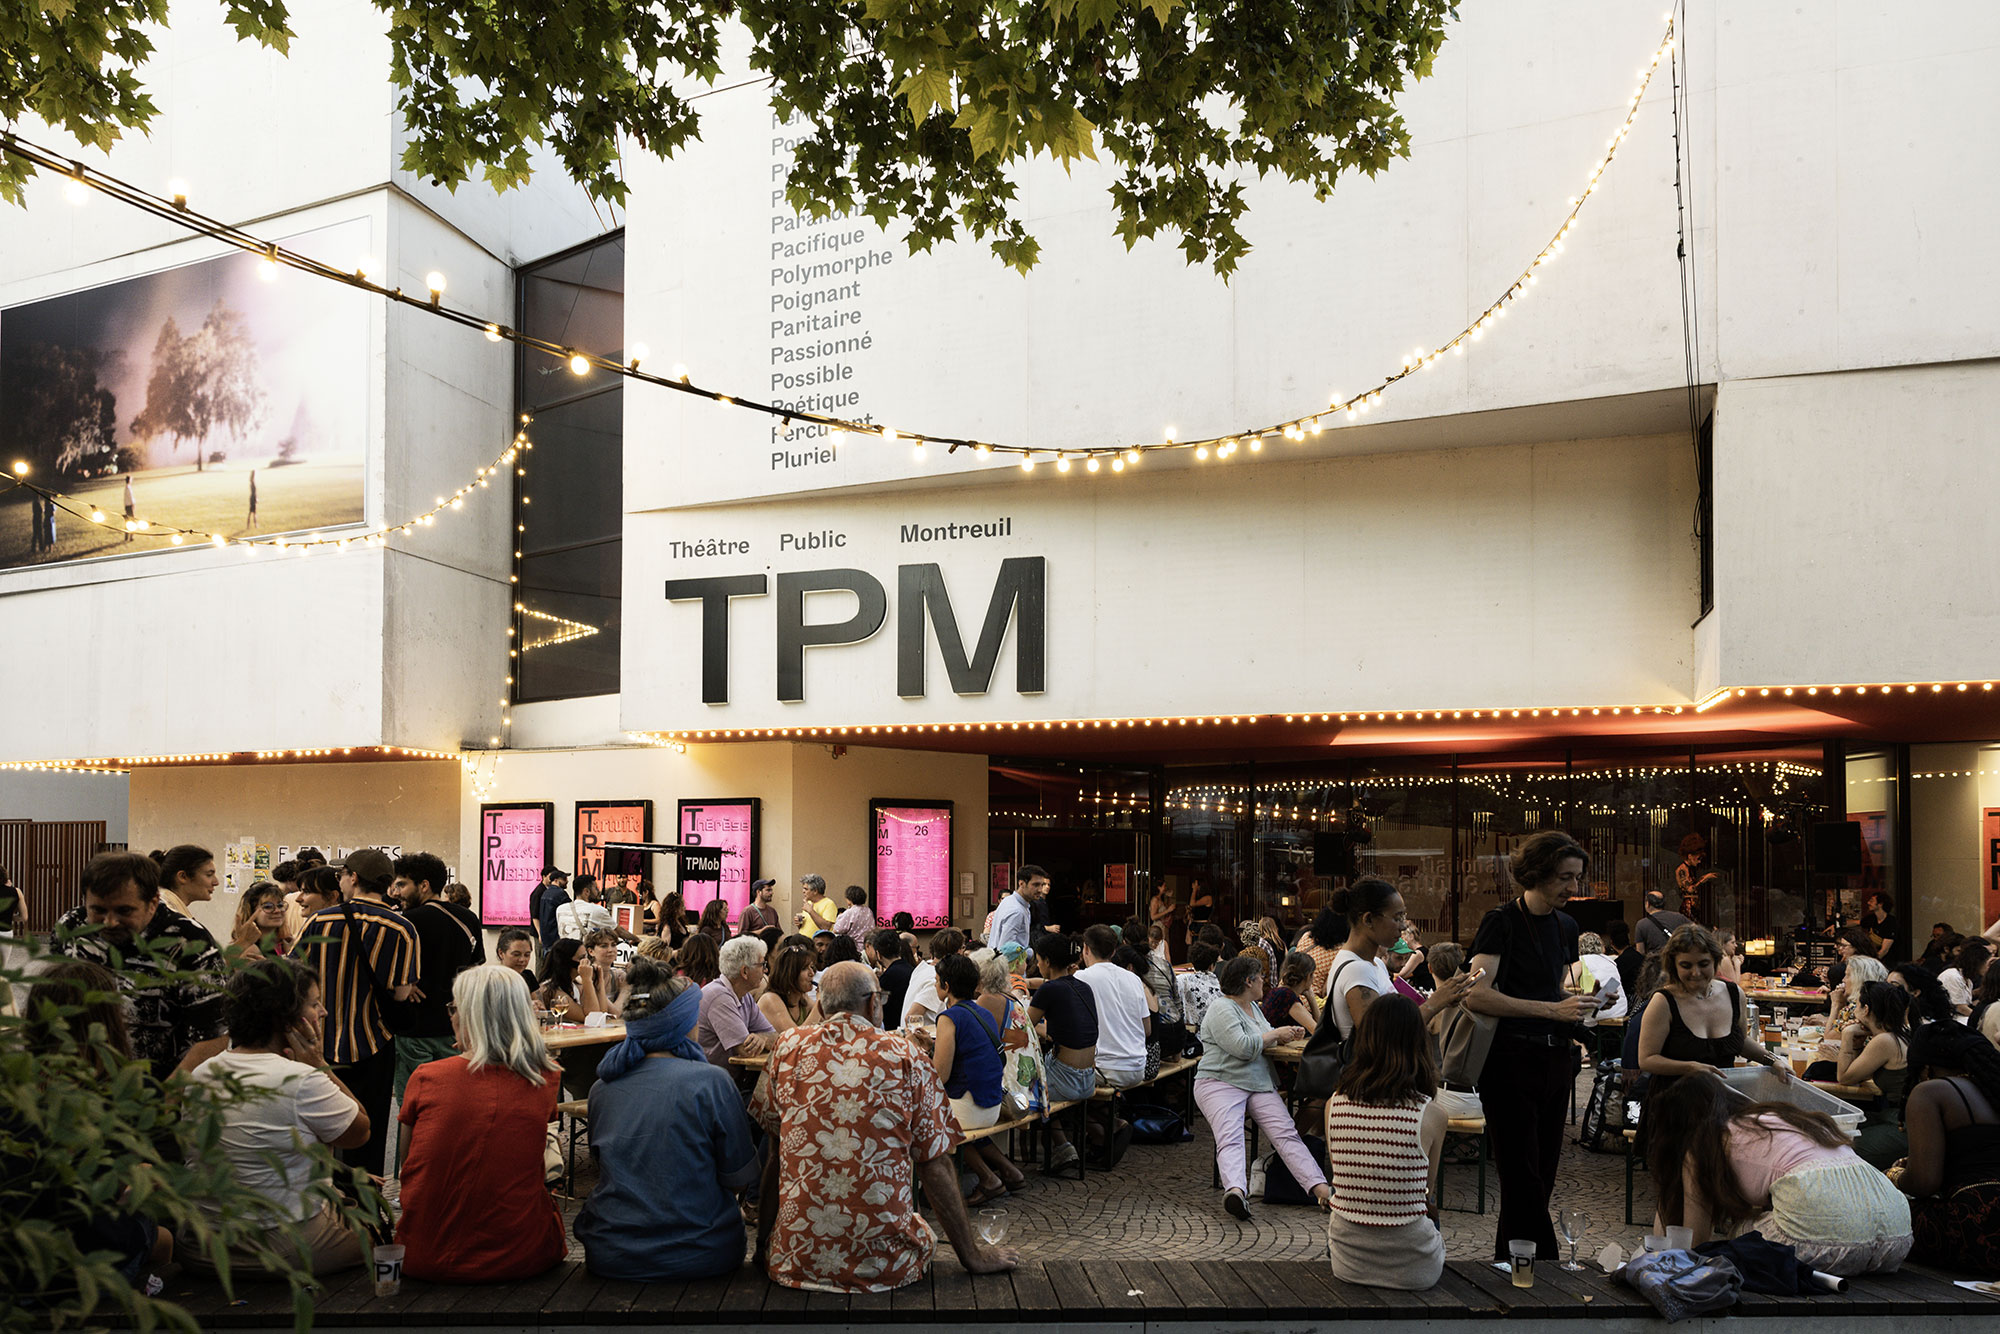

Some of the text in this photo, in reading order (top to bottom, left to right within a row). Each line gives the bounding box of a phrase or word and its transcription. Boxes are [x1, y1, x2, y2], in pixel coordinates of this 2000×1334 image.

[771, 229, 865, 260] Pacifique
[771, 249, 893, 286] Polymorphe
[771, 281, 861, 313] Poignant
[771, 310, 862, 339] Paritaire
[771, 330, 872, 365] Passionné
[771, 363, 853, 391] Possible
[771, 391, 859, 418] Poétique
[771, 444, 836, 470] Pluriel
[670, 517, 1012, 559] Théâtre Public Montreuil
[665, 555, 1048, 705] TPM
[914, 825, 929, 836] 26
[685, 856, 720, 871] TPMob
[878, 845, 893, 856] 25
